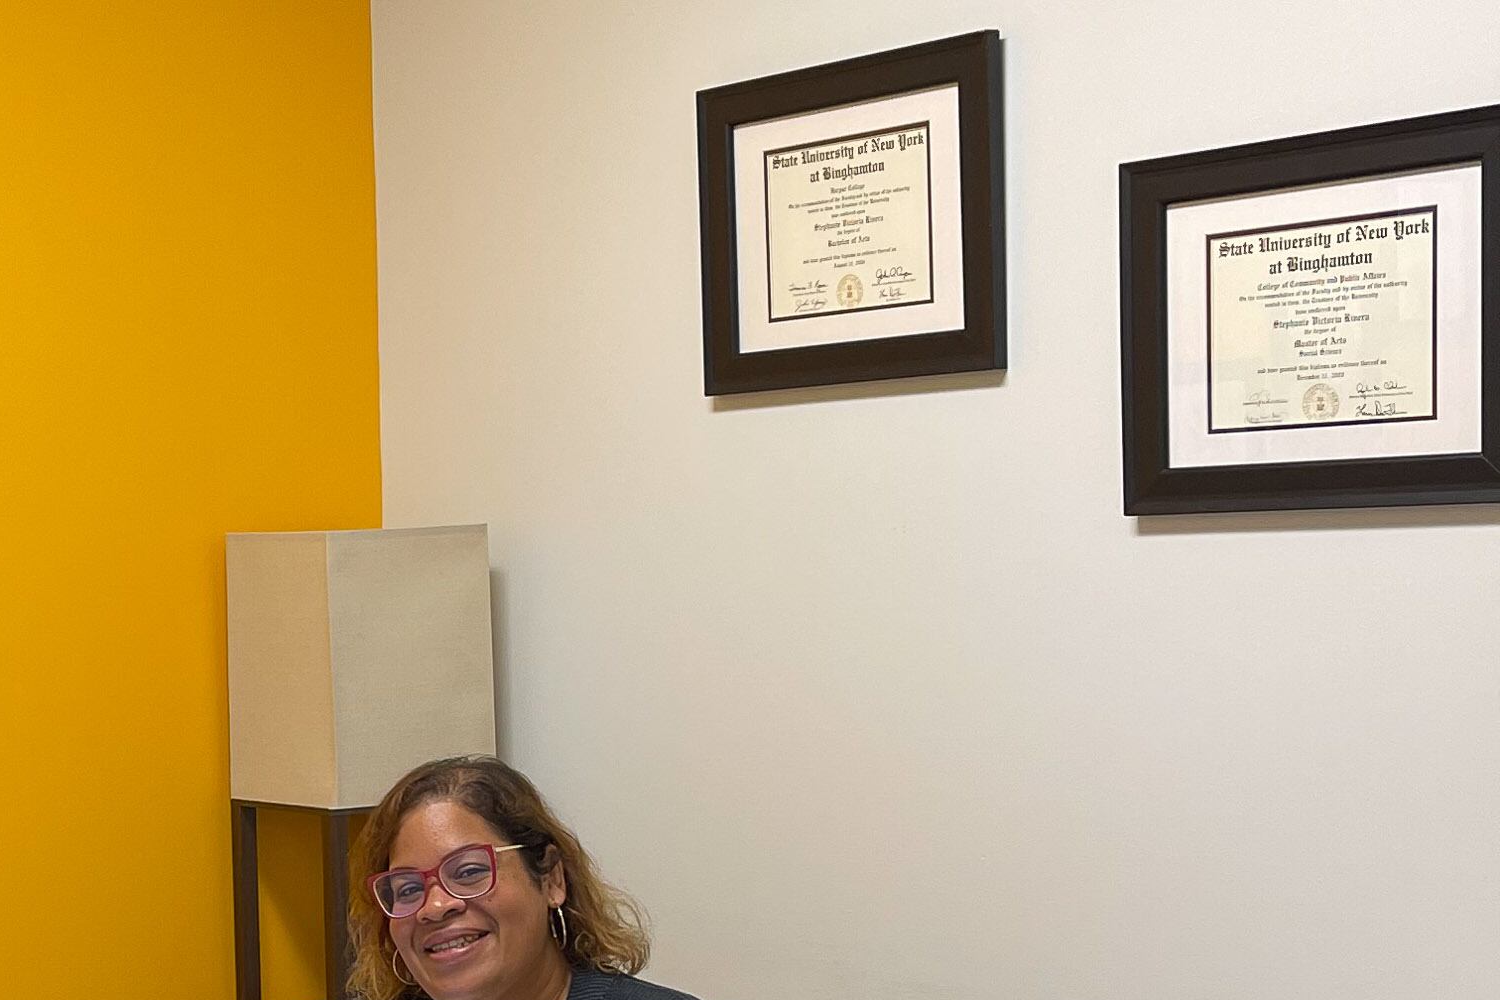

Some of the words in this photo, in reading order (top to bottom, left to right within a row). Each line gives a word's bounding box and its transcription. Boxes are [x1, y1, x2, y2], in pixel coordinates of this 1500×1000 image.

[772, 155, 798, 170] State
[801, 146, 854, 164] University
[857, 141, 868, 155] of
[871, 139, 895, 153] New
[898, 131, 924, 151] York
[810, 171, 820, 183] at
[822, 161, 885, 181] Binghamton
[1218, 242, 1254, 258] State
[1259, 233, 1331, 253] University
[1336, 227, 1351, 244] of
[1355, 225, 1388, 241] New
[1393, 218, 1430, 240] York
[1269, 260, 1282, 275] at
[1287, 252, 1373, 273] Binghamton
